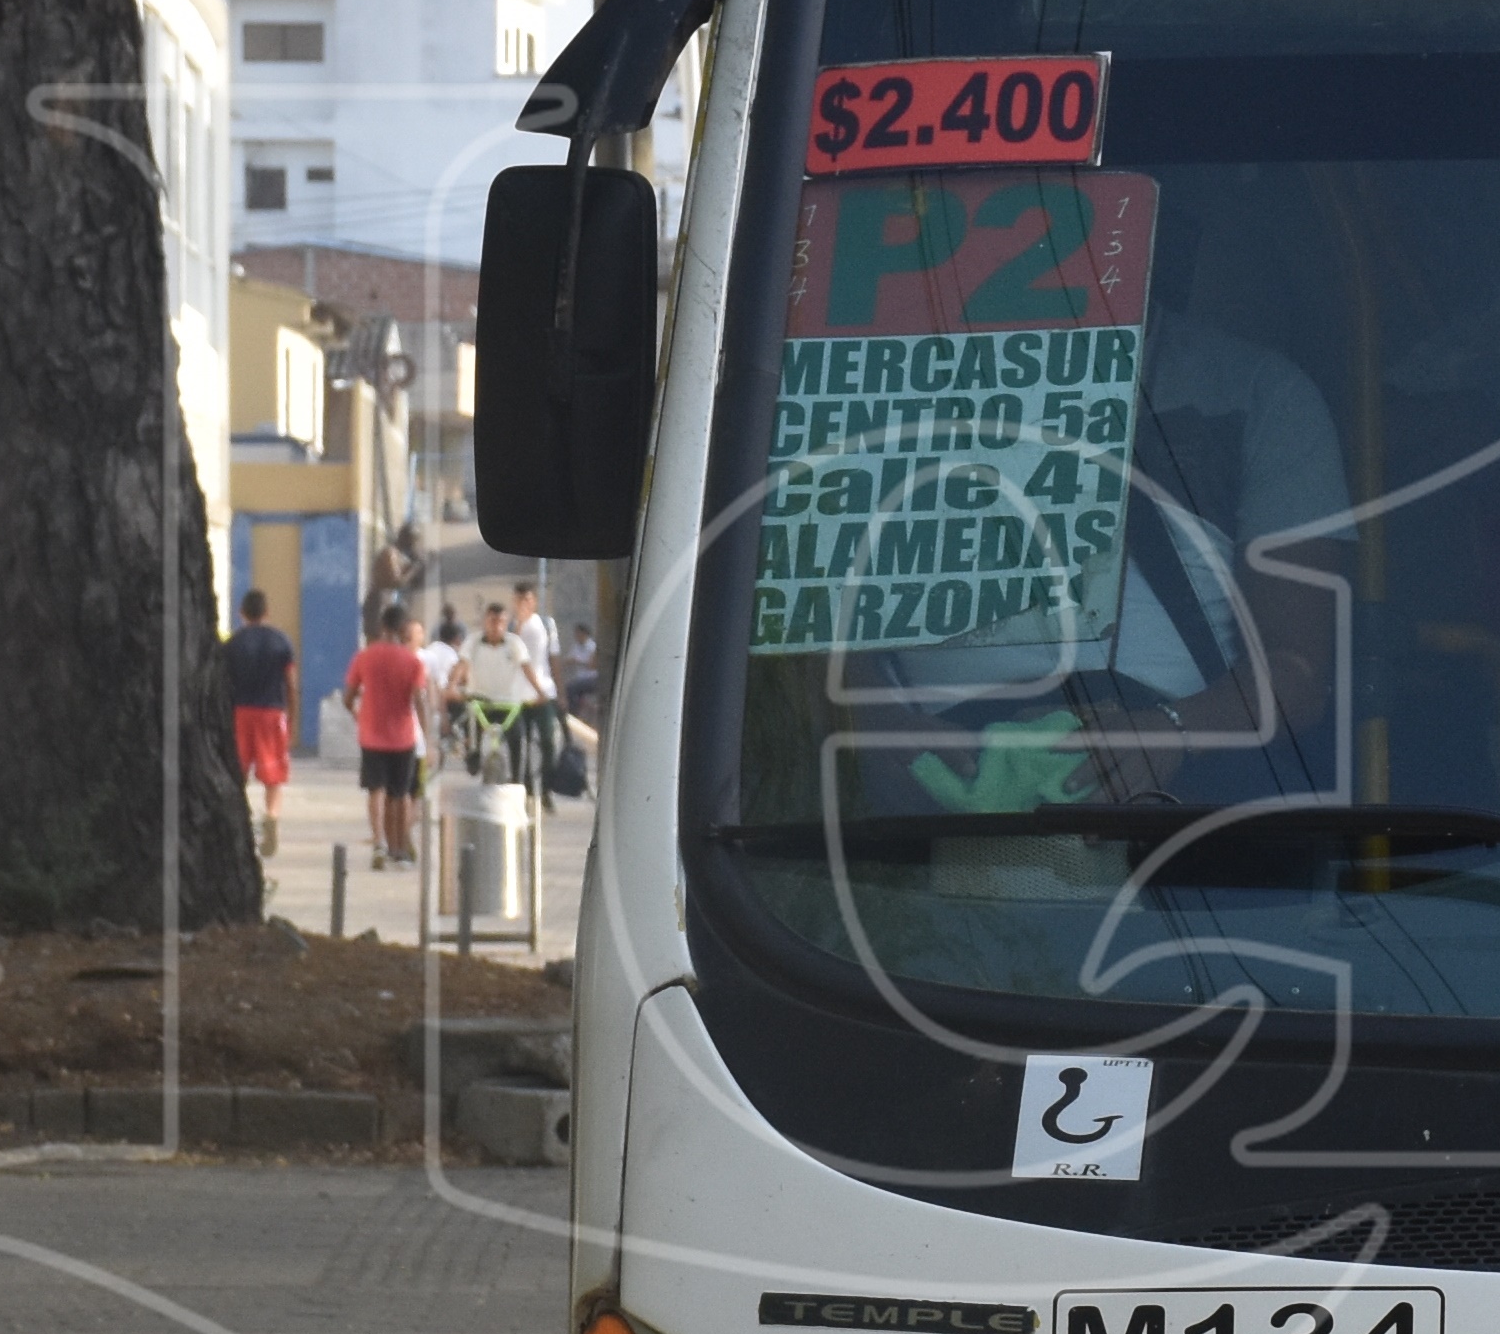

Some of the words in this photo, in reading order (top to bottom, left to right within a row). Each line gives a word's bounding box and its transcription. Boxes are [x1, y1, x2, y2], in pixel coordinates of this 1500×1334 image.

[814, 70, 1095, 161] $2.400
[826, 183, 1095, 327] P2
[778, 328, 1136, 396] MERCASUR
[768, 393, 1024, 457] CENTRO
[1041, 390, 1128, 447] 5a
[763, 456, 1000, 517] Calle
[1024, 447, 1126, 505] 41
[756, 510, 1116, 579] ALAMEDAS
[1051, 1163, 1107, 1177] R.R.
[784, 1301, 1024, 1333] TEMPLE
